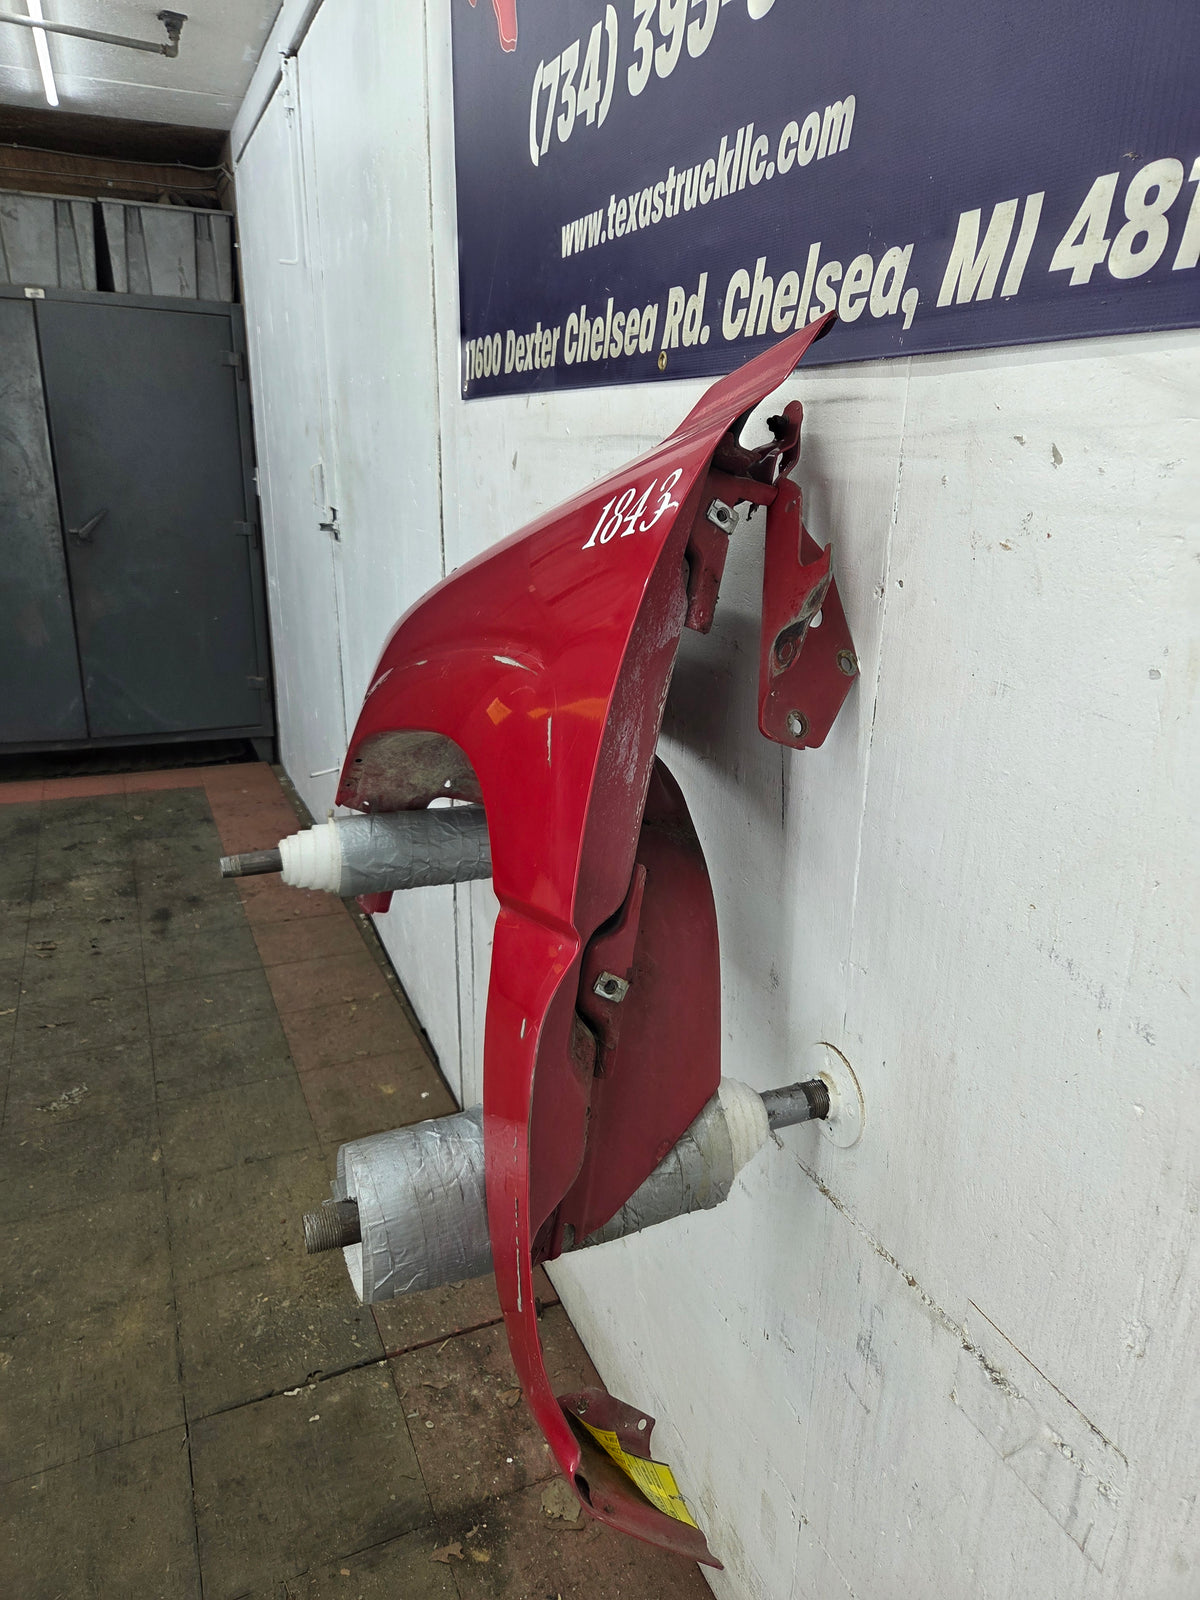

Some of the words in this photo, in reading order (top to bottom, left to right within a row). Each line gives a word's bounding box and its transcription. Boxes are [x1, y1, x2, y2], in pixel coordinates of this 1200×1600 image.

[529, 4, 618, 167] (734)
[561, 94, 856, 259] www.texastruckllc.com
[465, 332, 502, 381] 11600
[504, 321, 561, 374] Dexter
[563, 297, 658, 365] Chelsea
[661, 272, 710, 350] Rd.
[721, 241, 919, 341] Chelsea,
[936, 190, 1046, 308] MI
[581, 467, 683, 550] 1843
